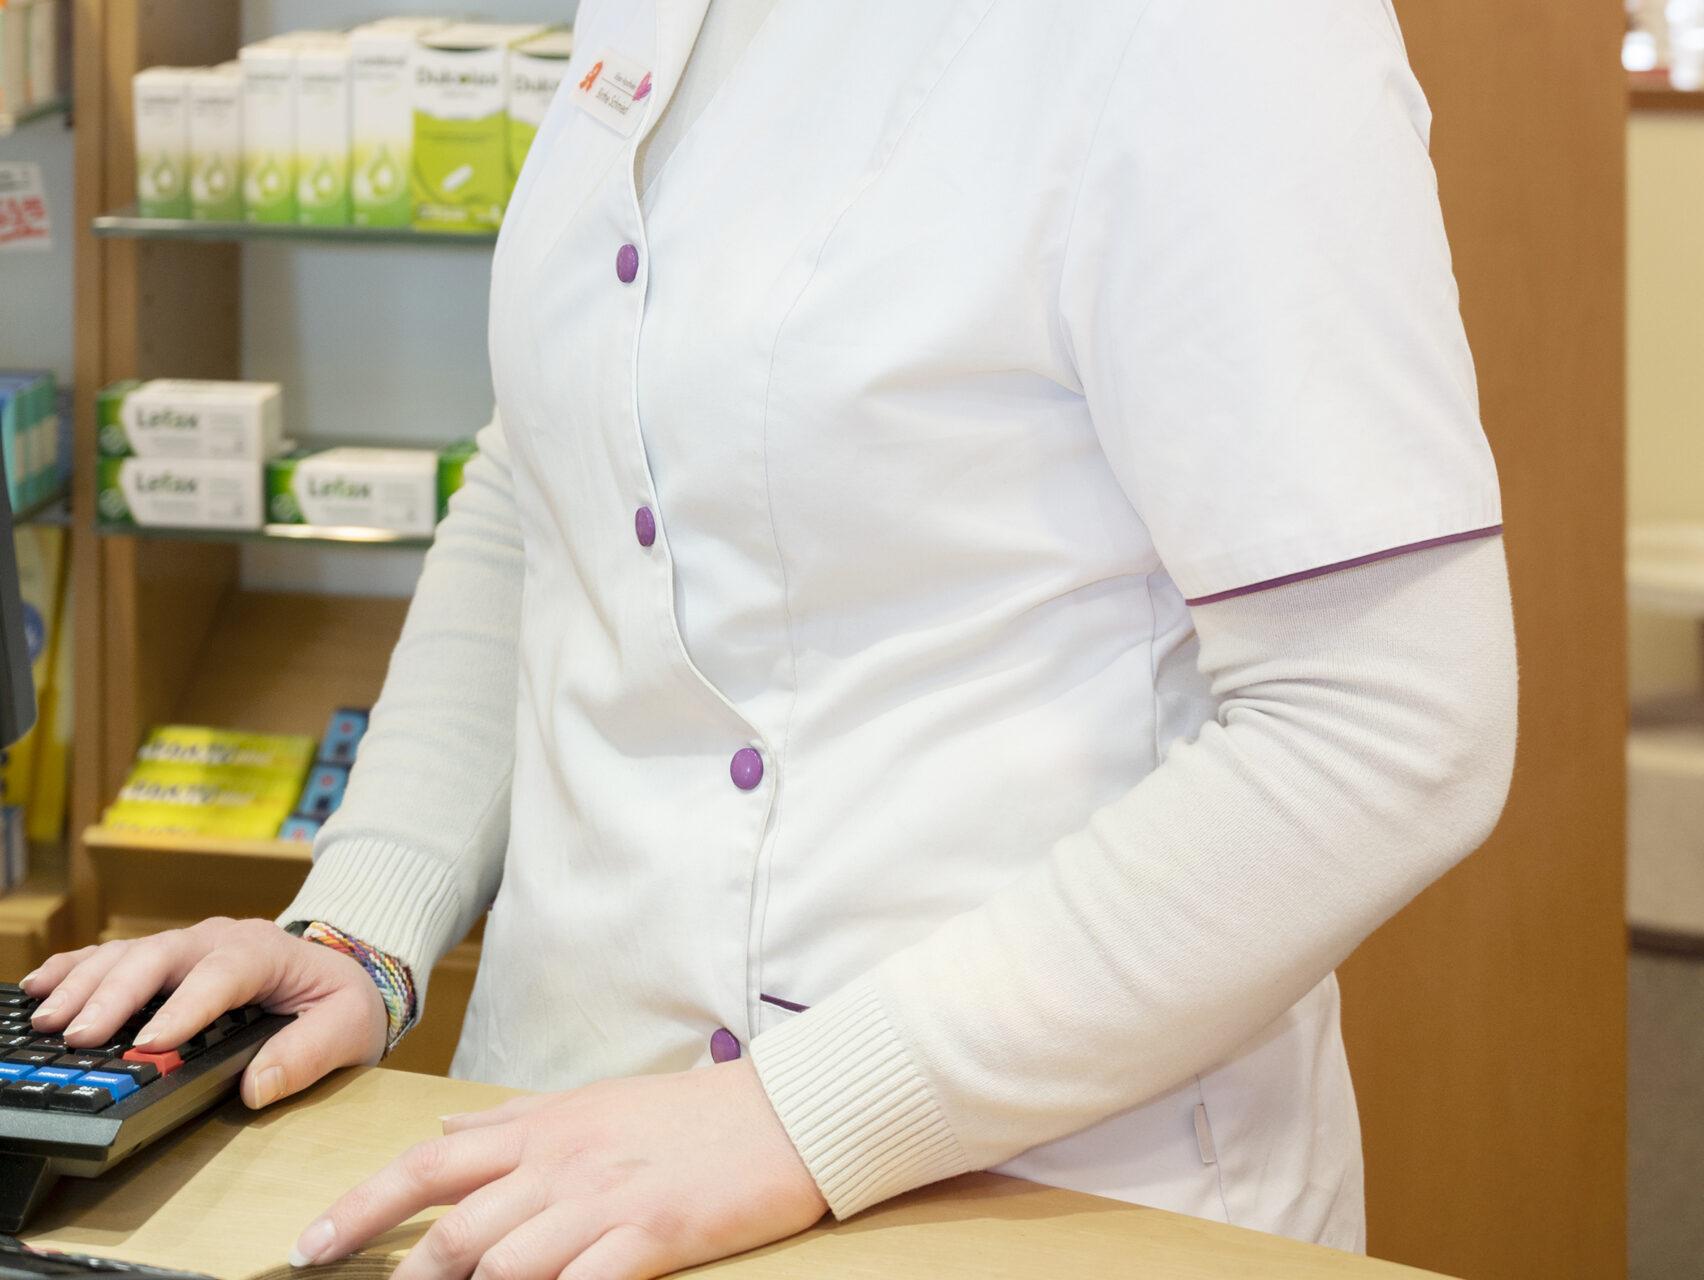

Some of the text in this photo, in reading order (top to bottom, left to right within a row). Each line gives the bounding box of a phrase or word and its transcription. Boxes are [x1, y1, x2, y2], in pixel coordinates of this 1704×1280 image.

[135, 408, 199, 431] Lefax
[135, 471, 198, 495] Lefax
[308, 475, 371, 499] Lefax
